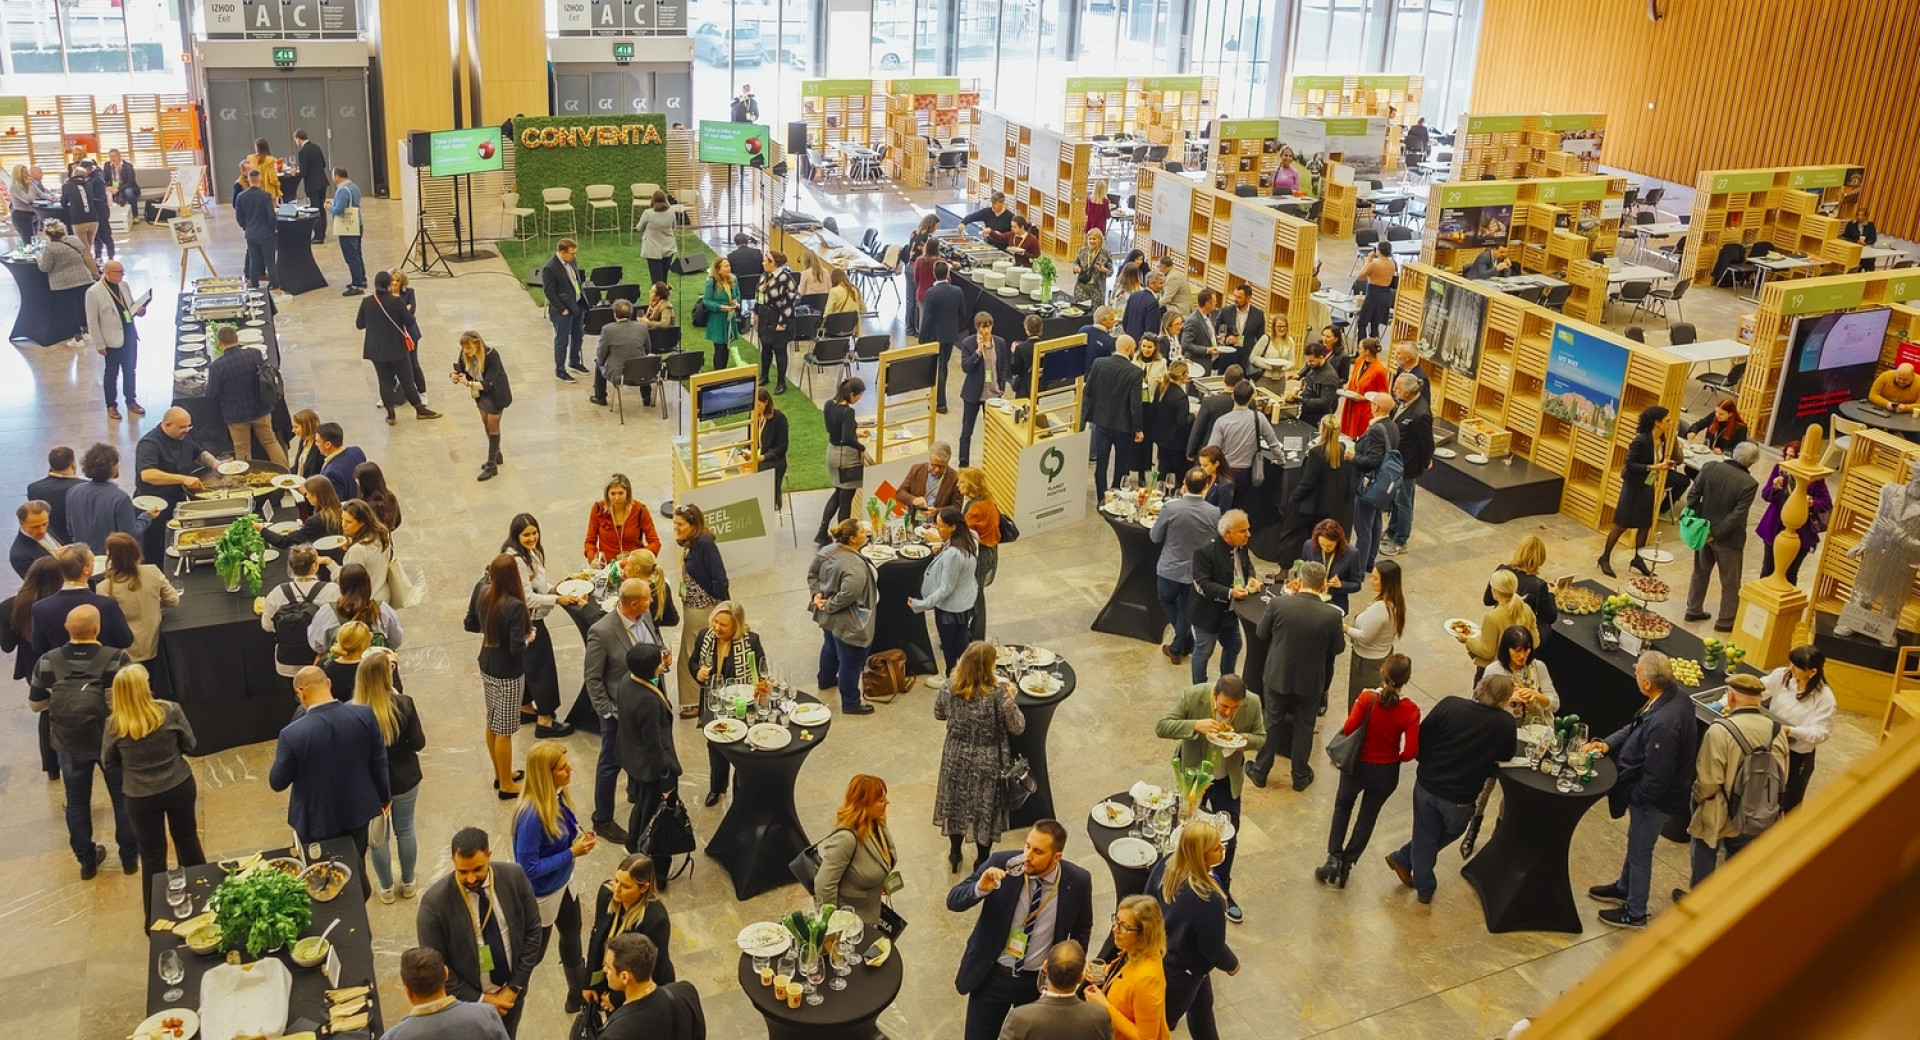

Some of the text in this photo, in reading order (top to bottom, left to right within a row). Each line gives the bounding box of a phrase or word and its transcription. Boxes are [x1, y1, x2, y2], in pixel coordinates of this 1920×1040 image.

[212, 4, 234, 12] IZHOD
[564, 4, 584, 12] IZHOD
[218, 14, 230, 22] Exit
[256, 5, 270, 27] A
[293, 5, 306, 27] C
[601, 4, 614, 25] A
[634, 4, 645, 25] C
[808, 84, 818, 92] 51
[900, 82, 910, 91] 50
[1472, 121, 1482, 129] 37
[1543, 120, 1552, 128] 36
[1225, 125, 1237, 135] 39
[521, 125, 662, 148] CONVENTA
[1718, 180, 1728, 189] 27
[1794, 176, 1804, 184] 26
[1449, 192, 1461, 203] 29
[1544, 188, 1556, 198] 28
[1894, 283, 1905, 296] 18
[1791, 294, 1804, 308] 19
[1047, 483, 1064, 491] PLANET
[1047, 487, 1066, 497] POSITIVE
[704, 510, 730, 524] FEEL
[708, 516, 752, 534] OVENIA
